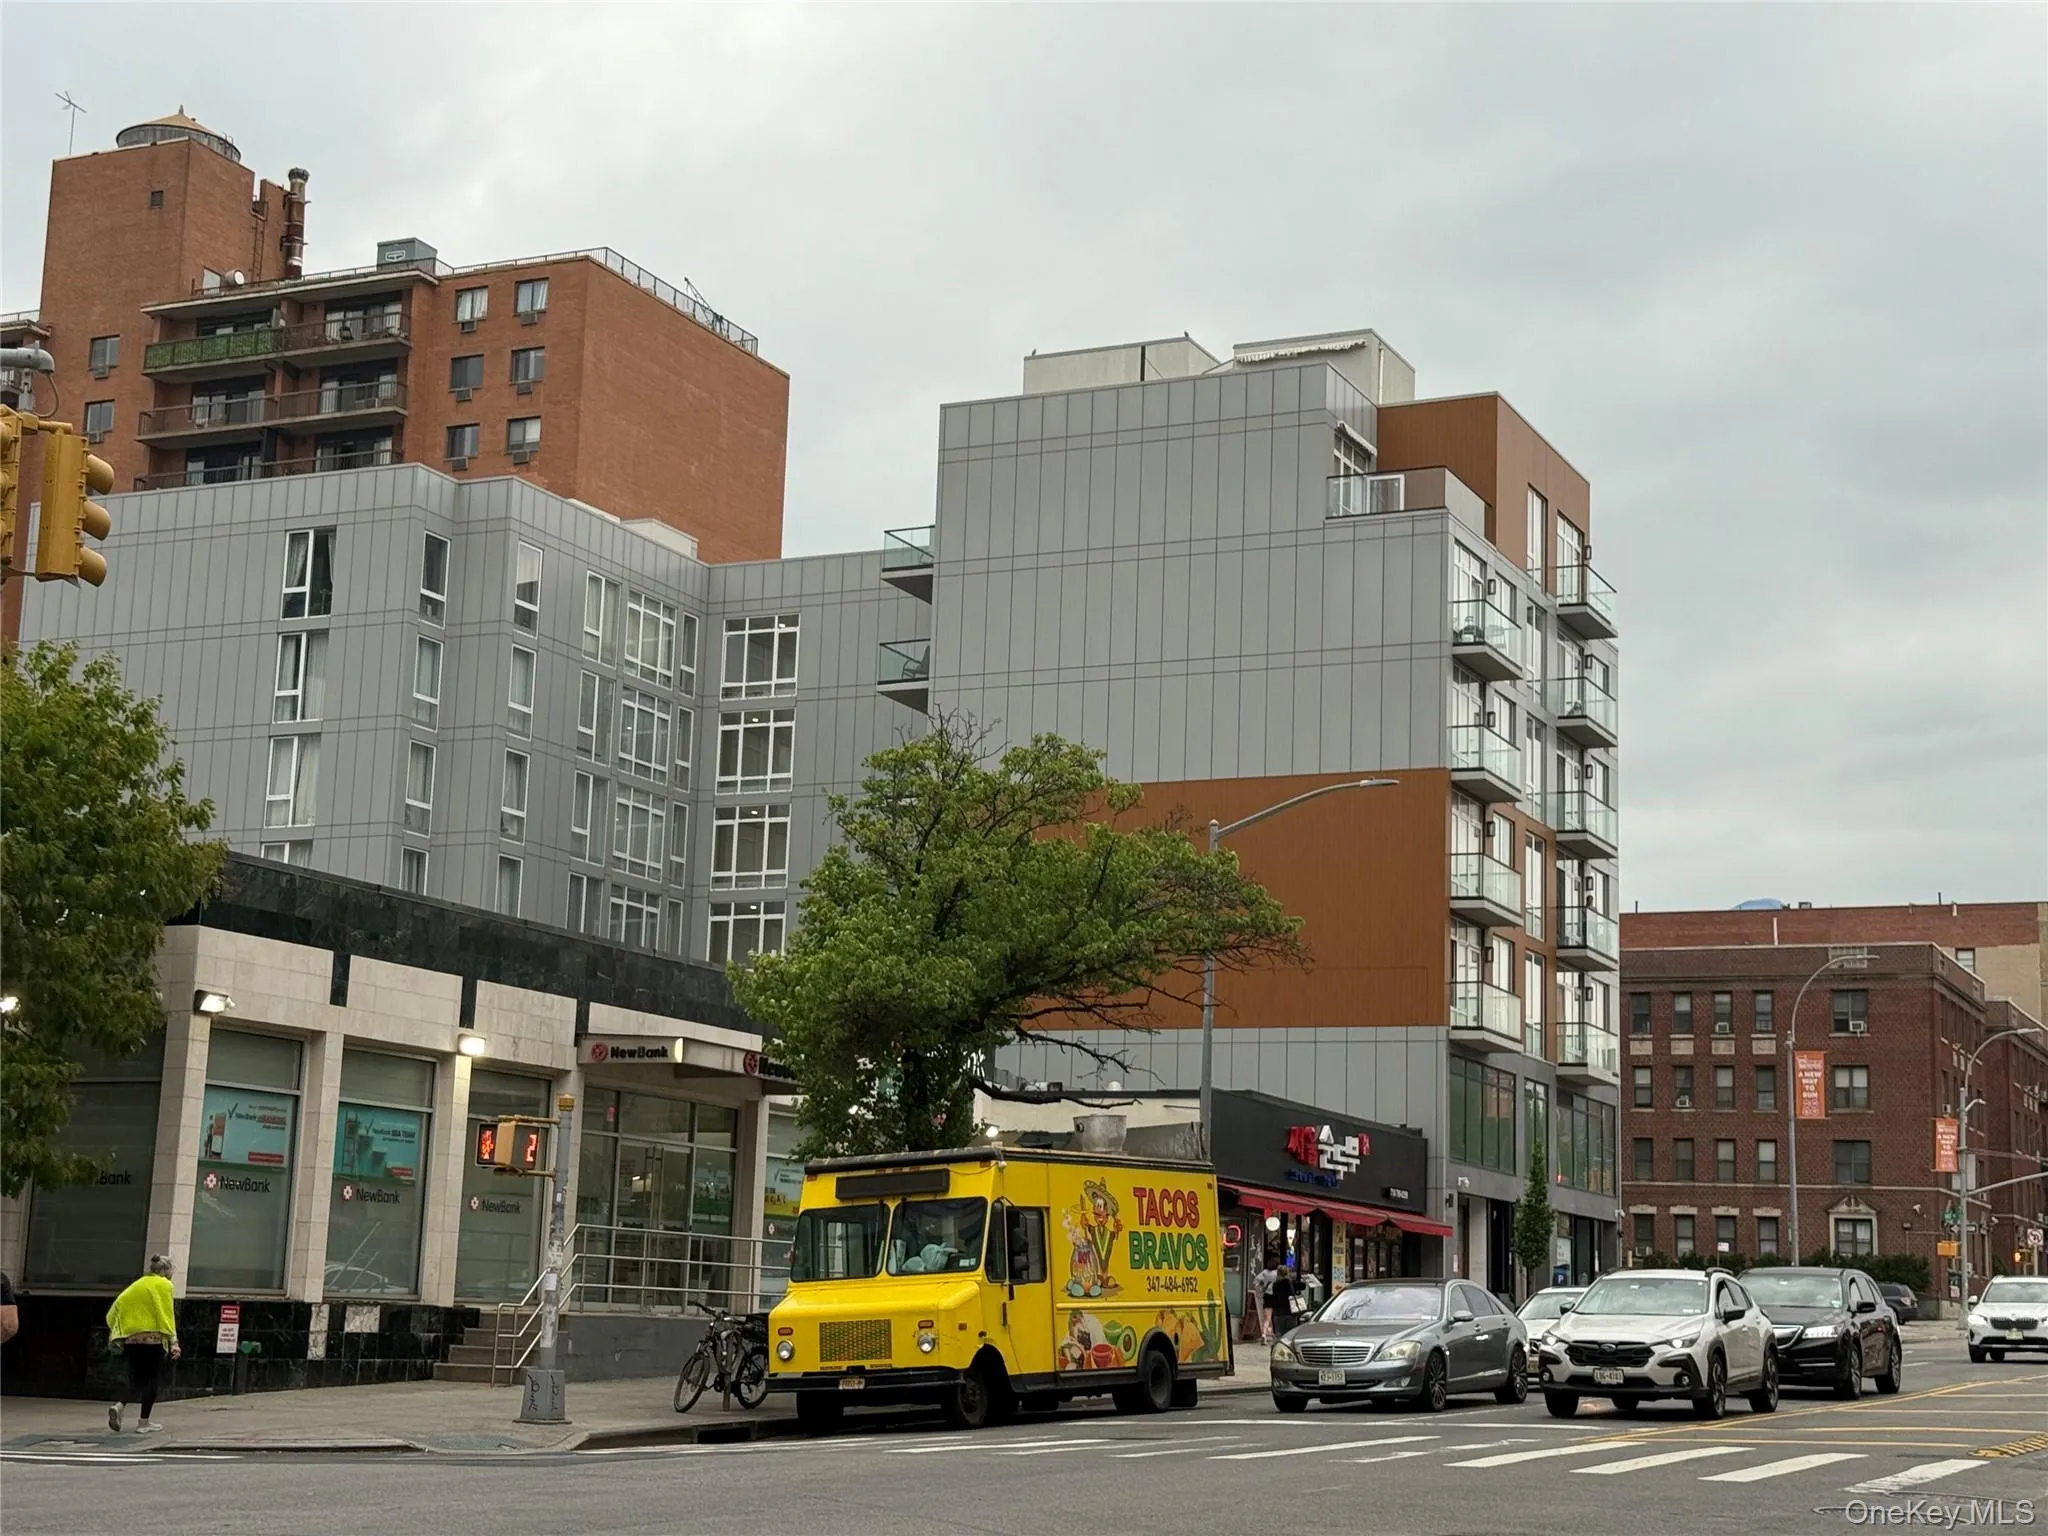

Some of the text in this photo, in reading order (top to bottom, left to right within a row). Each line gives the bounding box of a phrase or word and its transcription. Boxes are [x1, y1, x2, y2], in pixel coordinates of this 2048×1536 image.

[610, 1046, 668, 1059] NewBank
[526, 1134, 538, 1161] 2
[220, 1175, 271, 1193] NewBank
[356, 1188, 401, 1204] NewBank
[482, 1199, 521, 1214] NewBank
[1133, 1187, 1200, 1229] TACOS
[1129, 1231, 1209, 1272] BRAVOS
[1146, 1275, 1199, 1293] 347-484-6952
